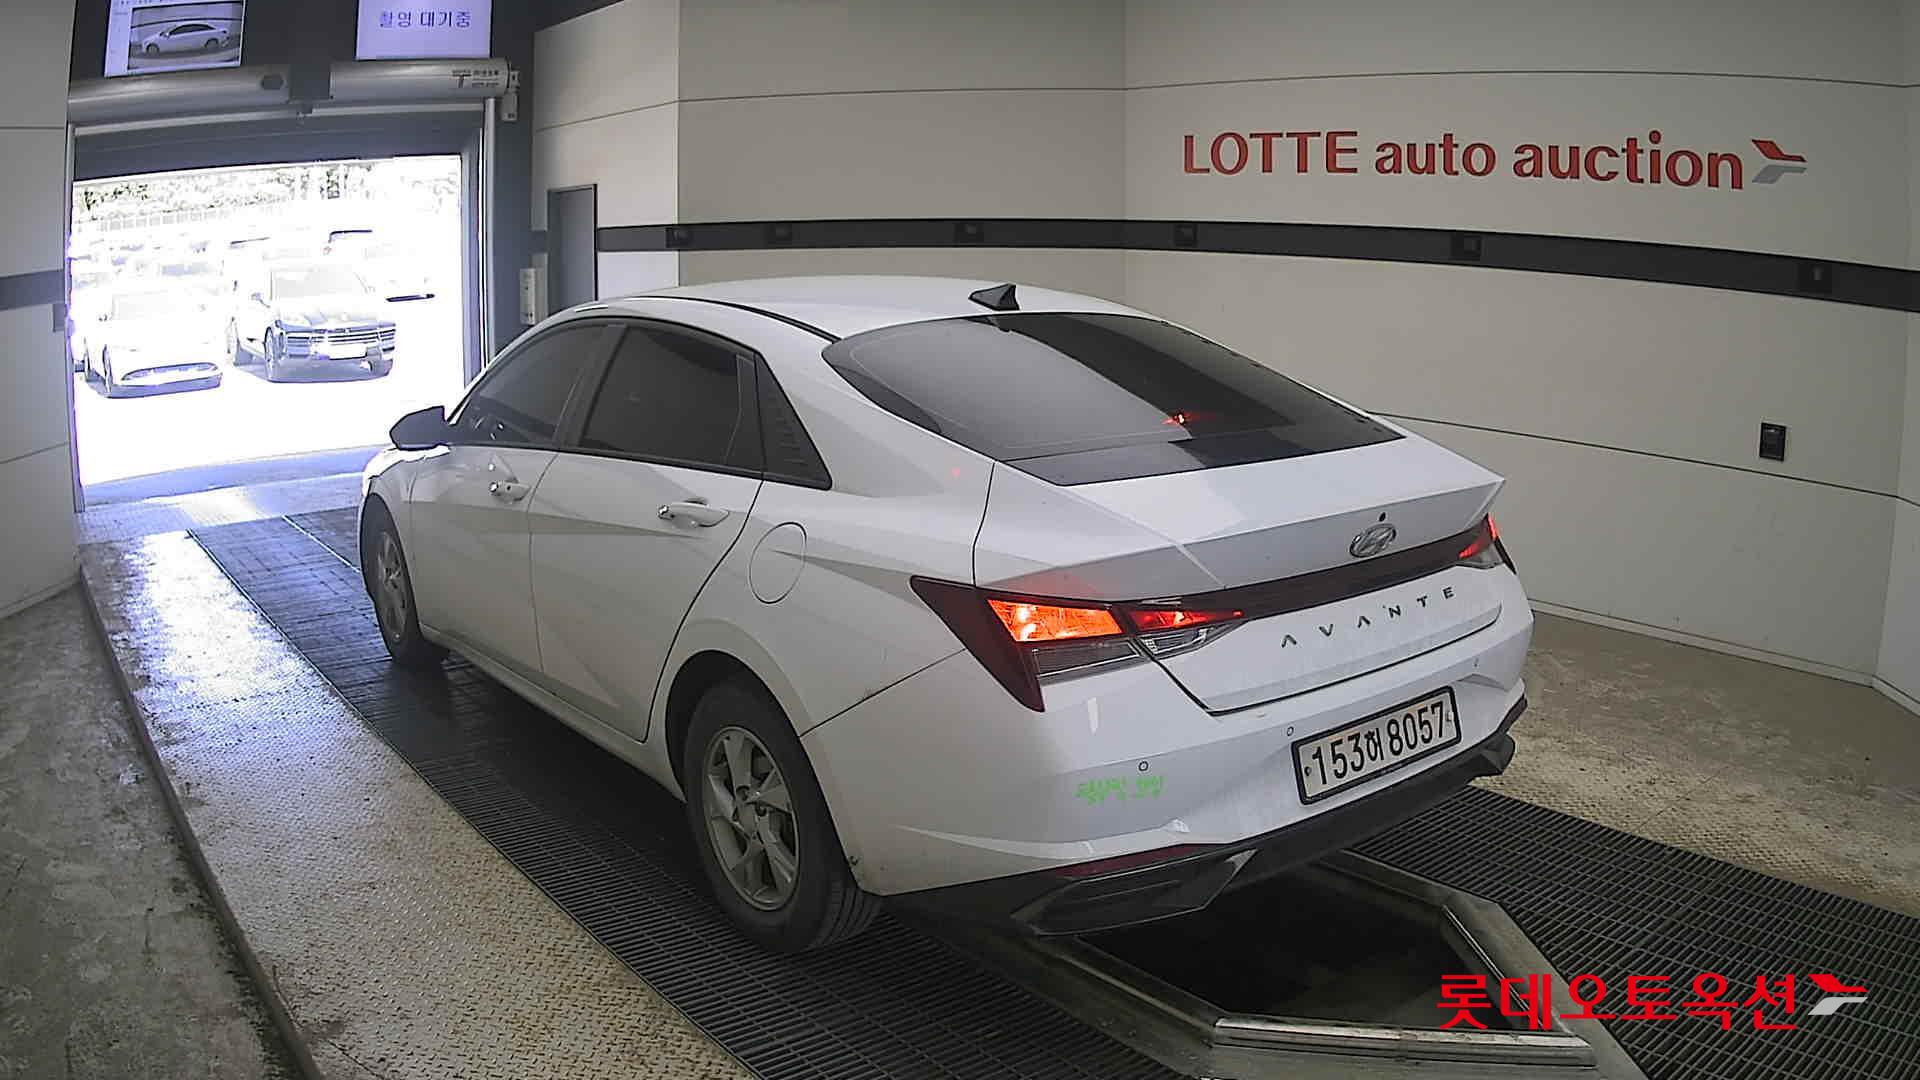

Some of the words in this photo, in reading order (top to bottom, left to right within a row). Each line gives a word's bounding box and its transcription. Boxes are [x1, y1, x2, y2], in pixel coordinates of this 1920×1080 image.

[420, 11, 471, 28] 대기중
[1183, 131, 1359, 176] LOTTE
[1376, 134, 1497, 178] auto
[1513, 130, 1744, 190] auction
[1280, 586, 1456, 648] AVANTE
[1311, 727, 1385, 785] 153허
[1386, 700, 1445, 757] 8057
